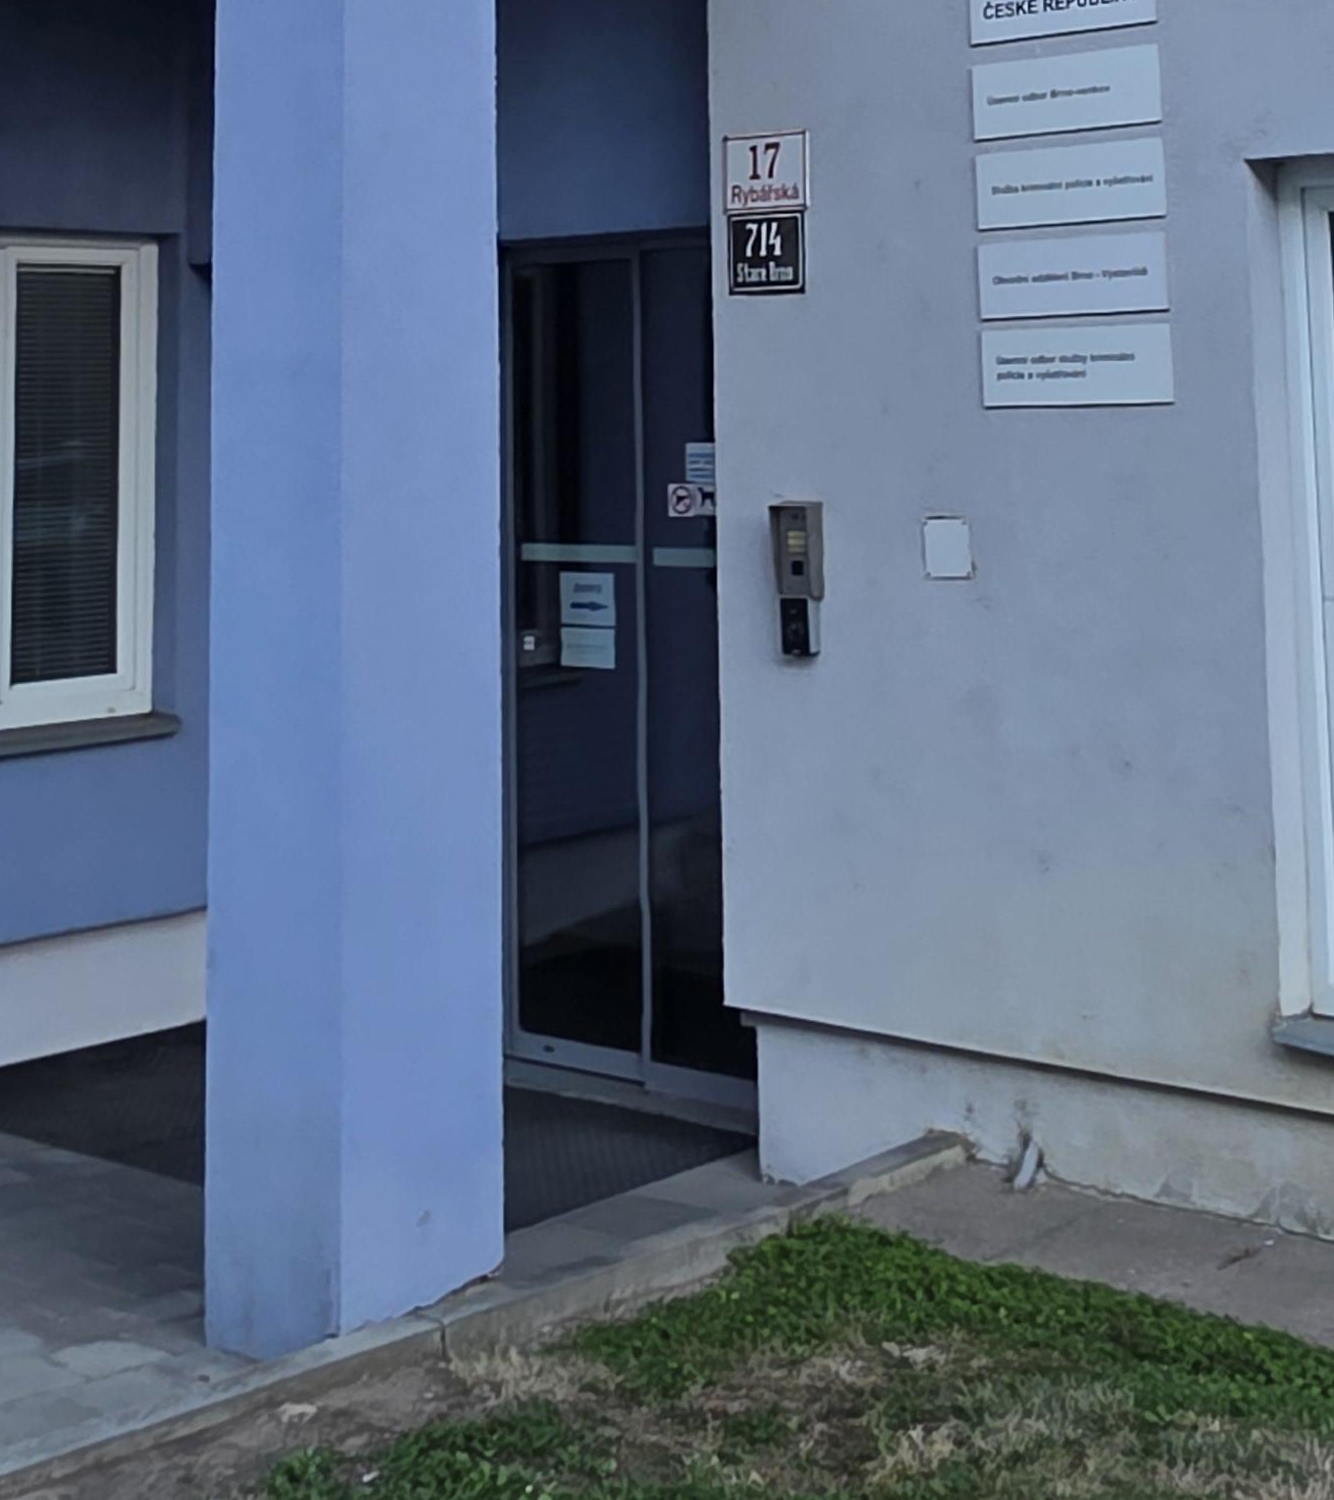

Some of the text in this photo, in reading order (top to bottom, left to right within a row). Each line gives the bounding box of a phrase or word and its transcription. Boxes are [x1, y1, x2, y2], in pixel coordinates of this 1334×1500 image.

[748, 141, 781, 181] 17
[731, 182, 800, 207] Rybářská
[745, 221, 783, 258] 714
